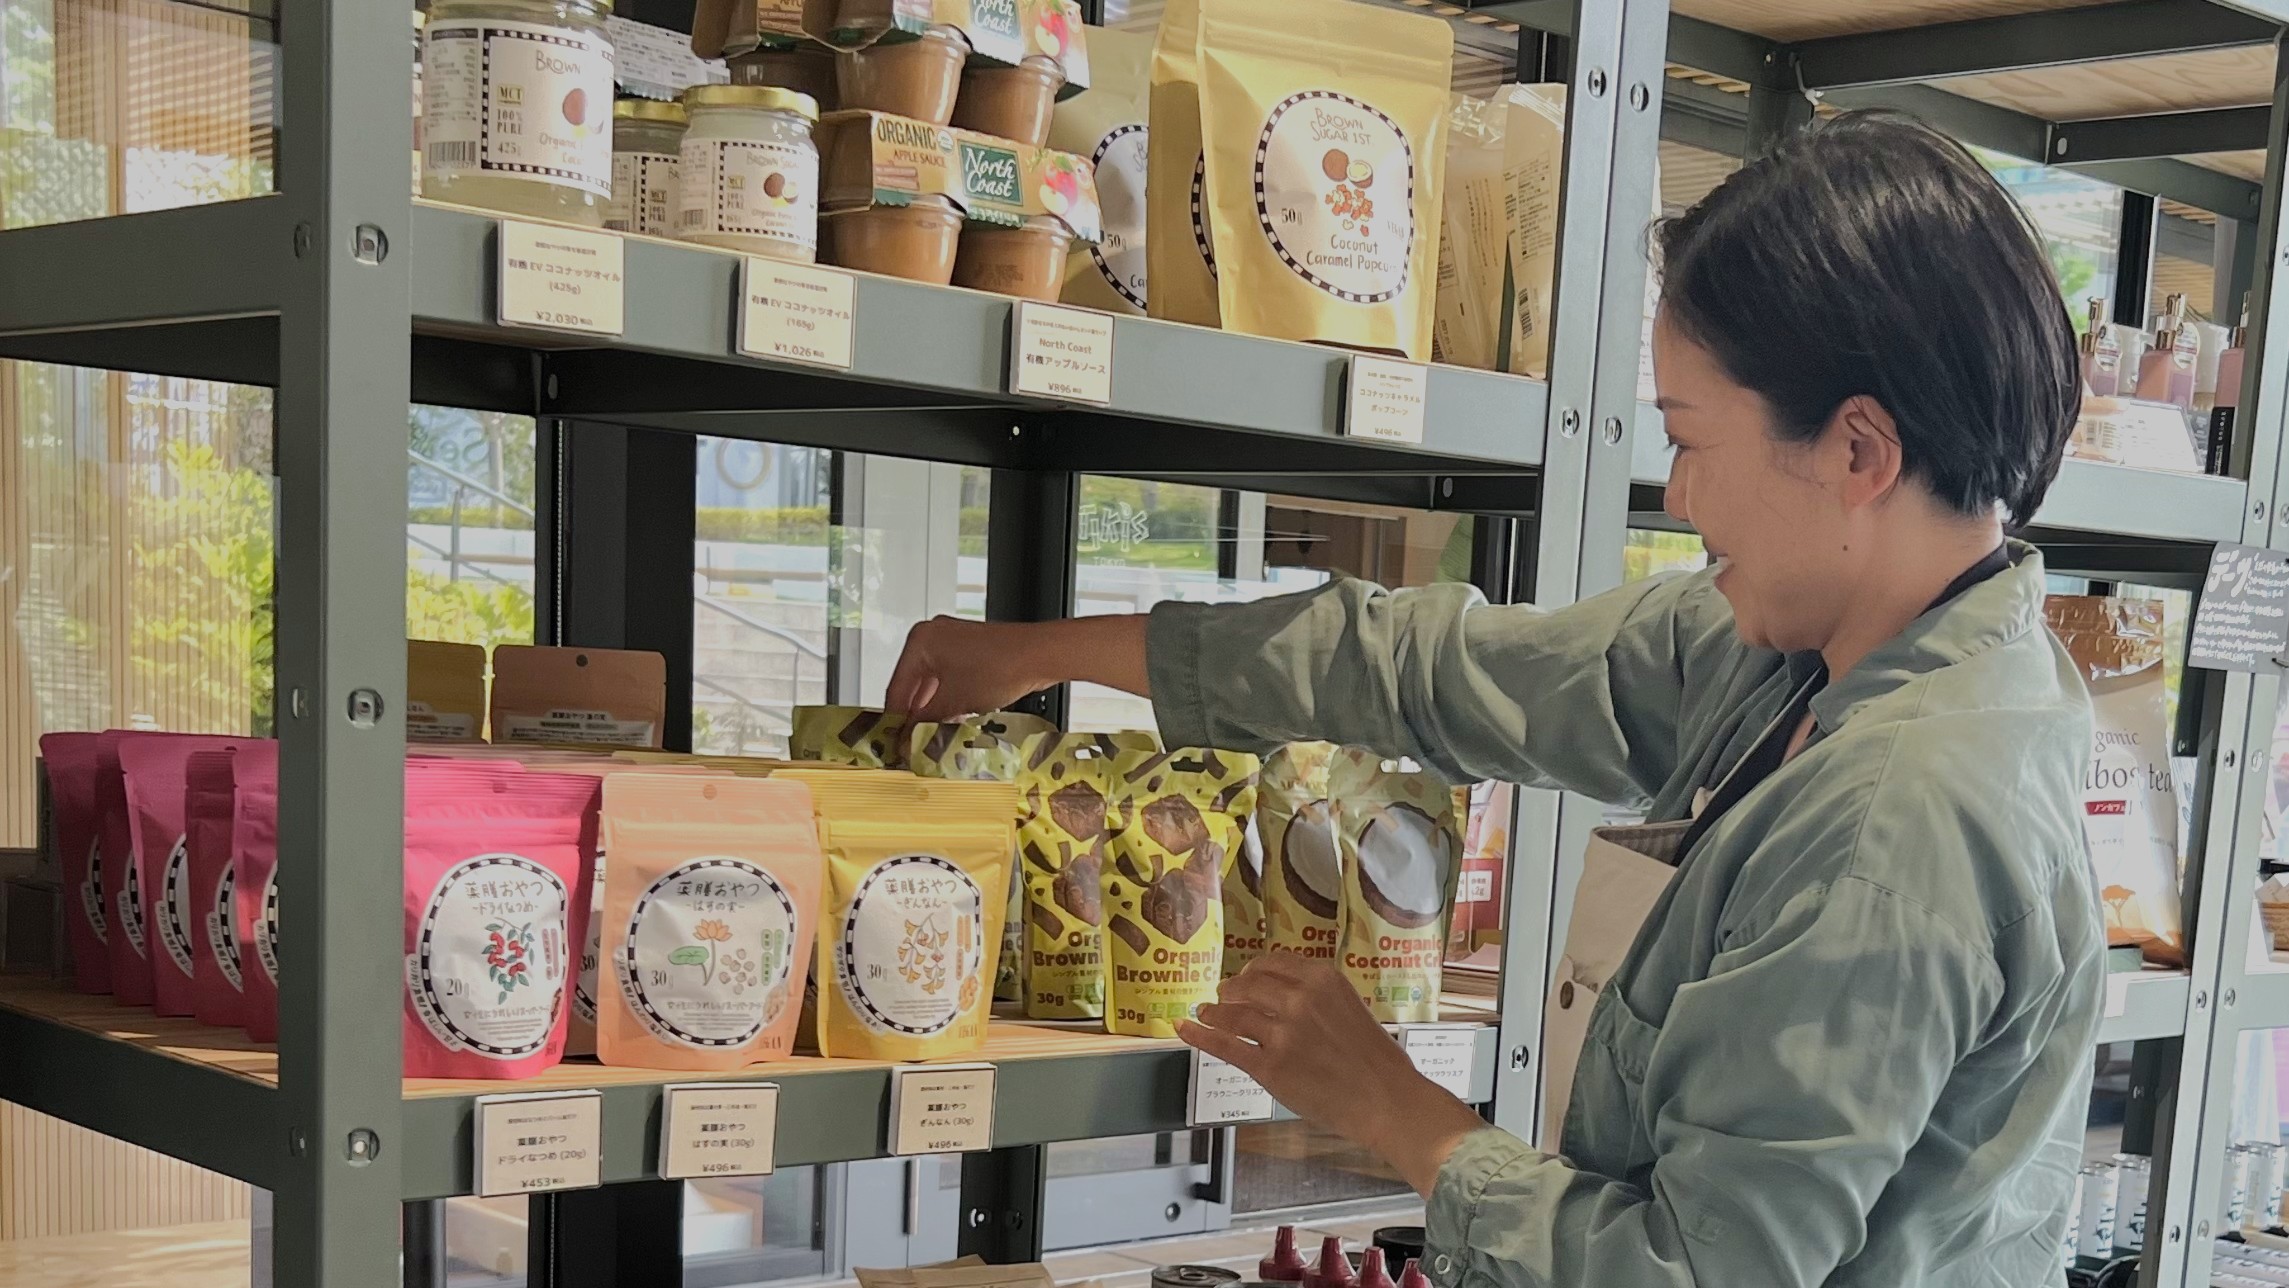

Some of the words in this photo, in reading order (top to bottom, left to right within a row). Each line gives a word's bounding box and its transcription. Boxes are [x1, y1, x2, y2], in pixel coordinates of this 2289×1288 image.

[974, 4, 1014, 35] Coast
[535, 50, 581, 75] BROWN
[1315, 107, 1363, 131] BROWN
[877, 119, 938, 150] ORGANIC
[1310, 121, 1349, 142] SUGAR
[894, 150, 918, 163] APPLE
[920, 154, 947, 168] SAUCE
[965, 147, 1016, 180] North
[966, 170, 1015, 198] Coast
[1330, 234, 1379, 255] Coconut
[1306, 251, 1353, 269] Caramel
[529, 261, 543, 271] EV
[545, 263, 620, 282] ココナッツオイル
[536, 310, 579, 325] ¥2,030
[784, 301, 850, 320] ココナッツオイル
[775, 342, 812, 357] ¥1,026
[1039, 337, 1066, 350] North
[1067, 342, 1092, 355] Coast
[1025, 353, 1106, 375] 有機アップルソース
[2094, 728, 2142, 753] ganic
[464, 880, 544, 900] 薬膳おやつ
[677, 881, 760, 897] 薬膳おやつ
[885, 878, 957, 896] 薬膳おやつ
[1379, 933, 1442, 954] Organic
[1033, 950, 1104, 967] Brown
[1345, 952, 1422, 969] Coconut
[1116, 965, 1200, 983] Brownie
[1037, 992, 1065, 1006] 30g
[1117, 1008, 1145, 1024] 30g
[1221, 1110, 1240, 1118] ¥345
[920, 1119, 951, 1128] ぎんなん
[498, 1151, 558, 1165] ドライなつめ
[702, 1162, 730, 1172] ¥496
[521, 1177, 551, 1188] ¥453
